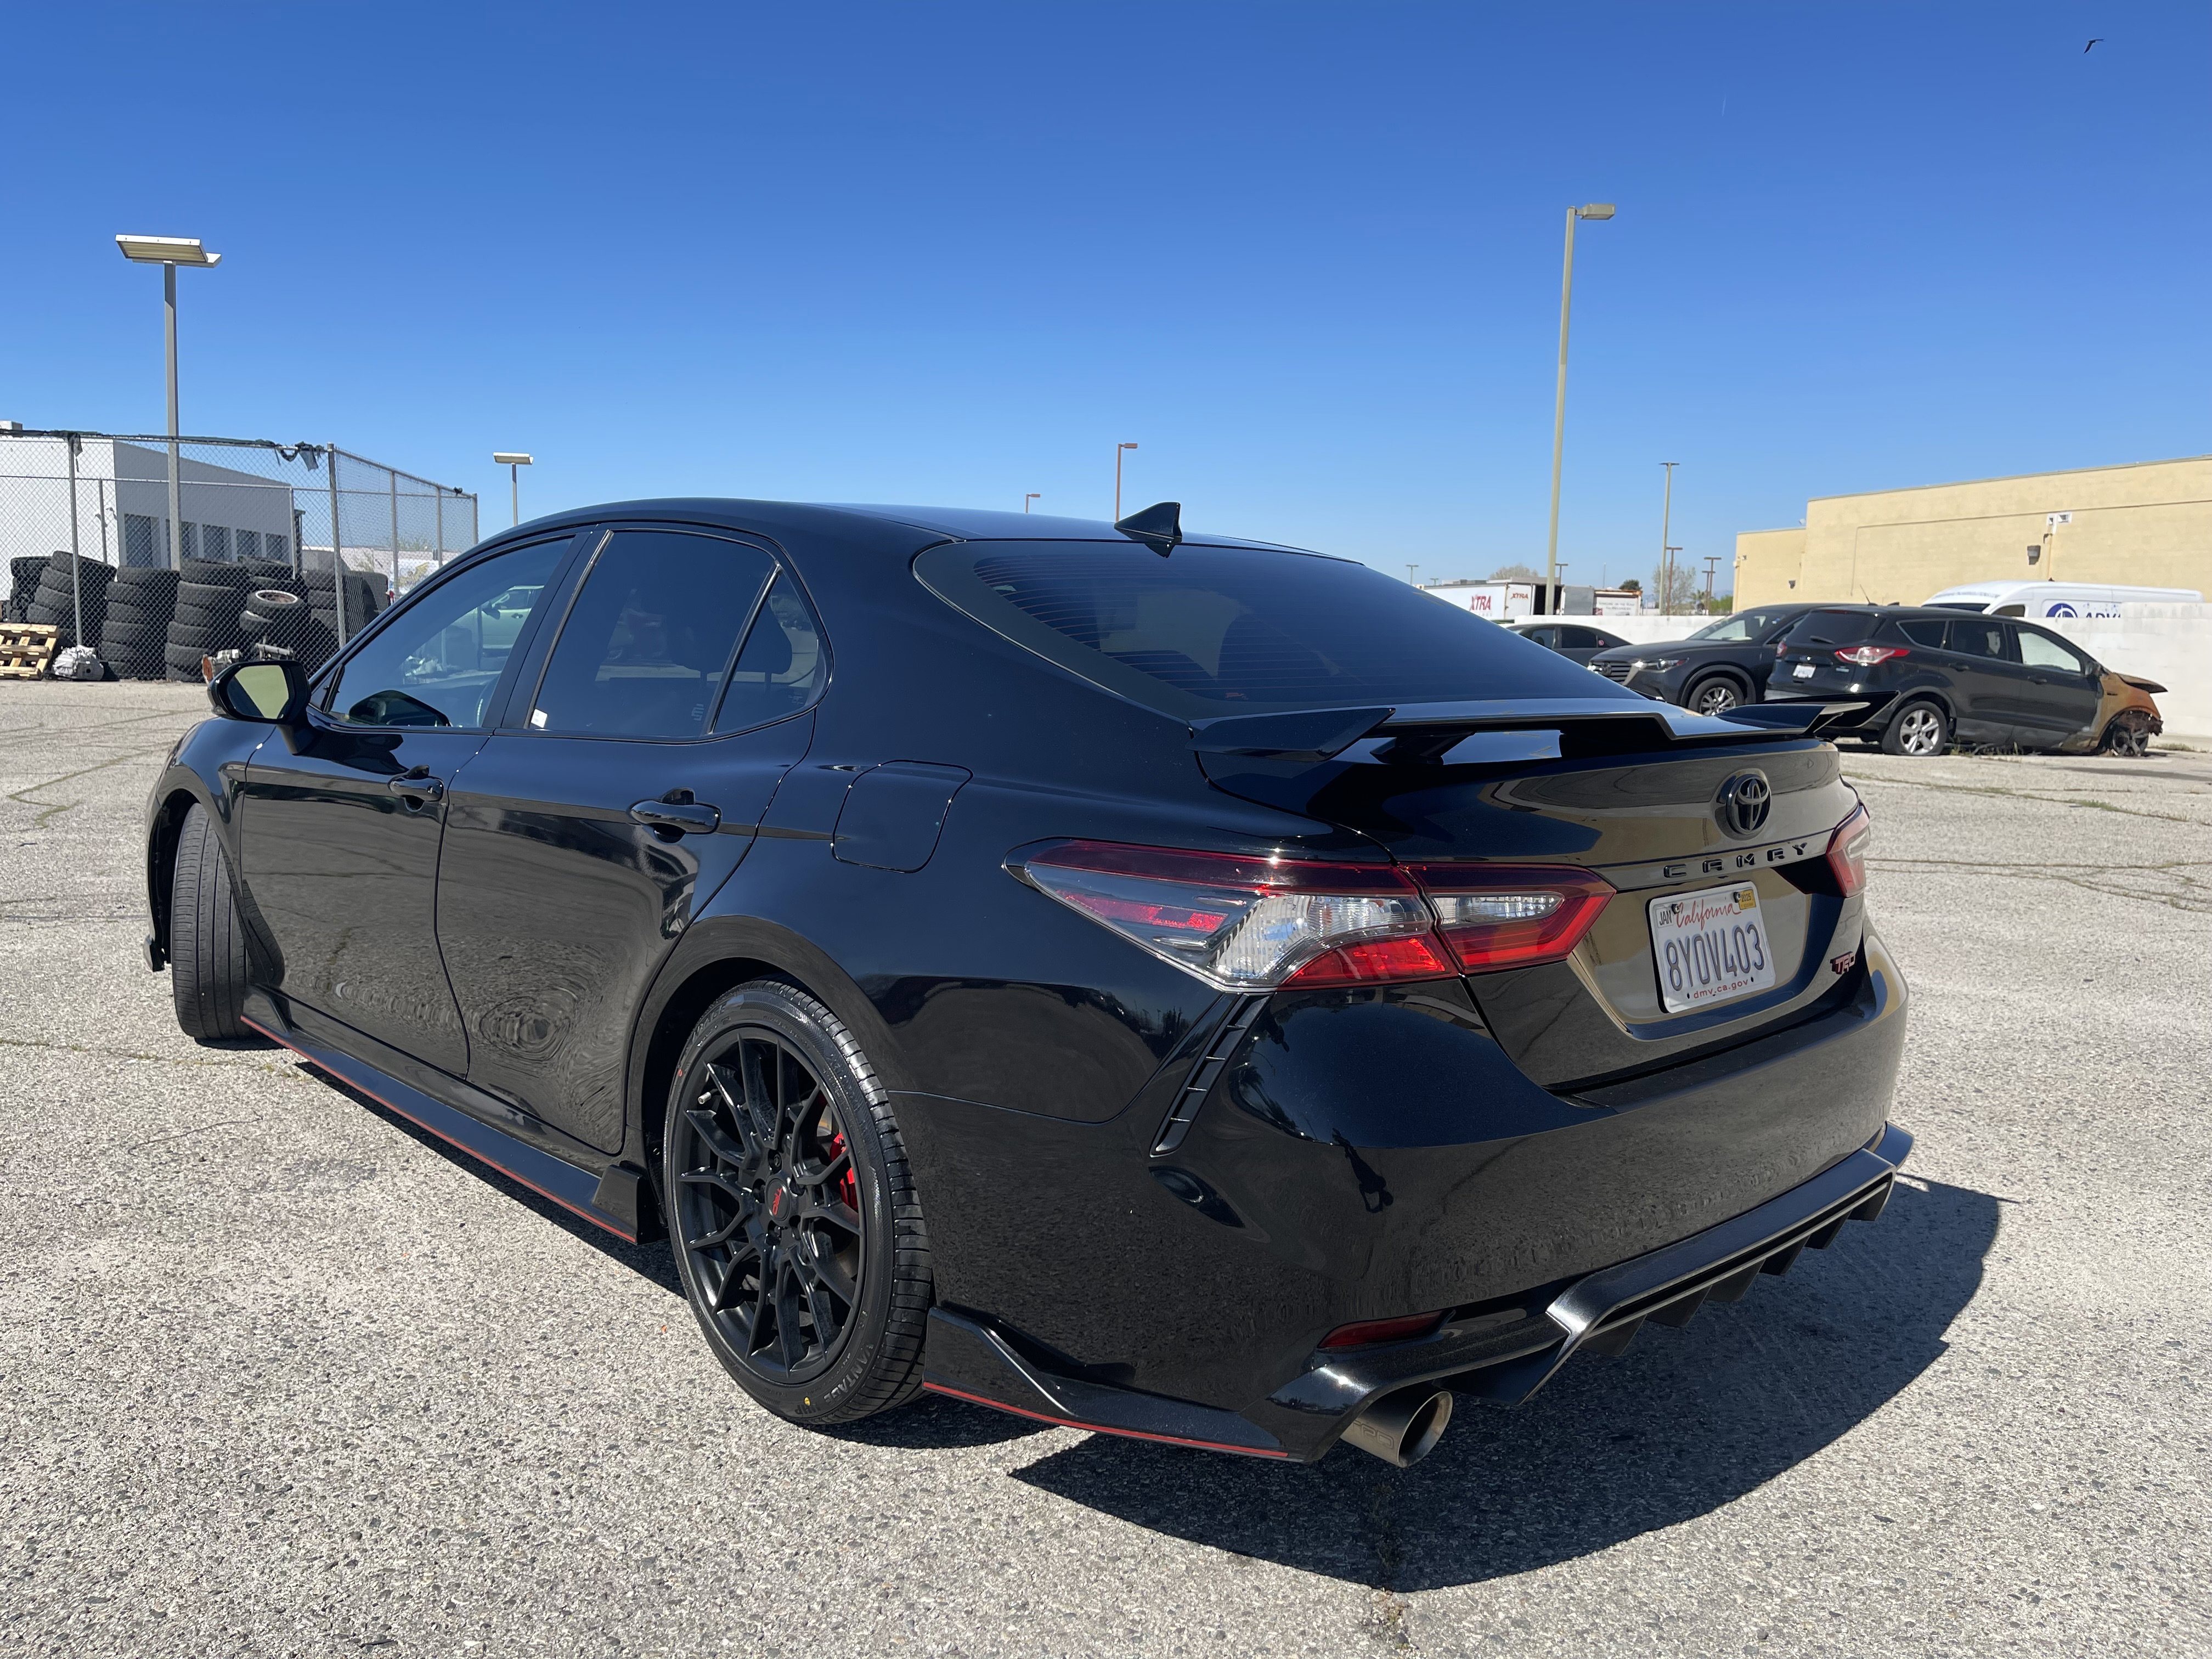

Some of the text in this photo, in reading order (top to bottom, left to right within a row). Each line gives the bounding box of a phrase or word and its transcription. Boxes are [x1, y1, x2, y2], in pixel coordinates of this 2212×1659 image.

[1470, 595, 1491, 610] XTRA
[1663, 843, 1807, 878] CAMRY
[1659, 910, 1672, 926] JAN
[1676, 898, 1742, 931] California
[1831, 951, 1855, 974] TRD
[1693, 979, 1748, 998] dmv.ca.gov
[772, 1187, 783, 1216] TRD
